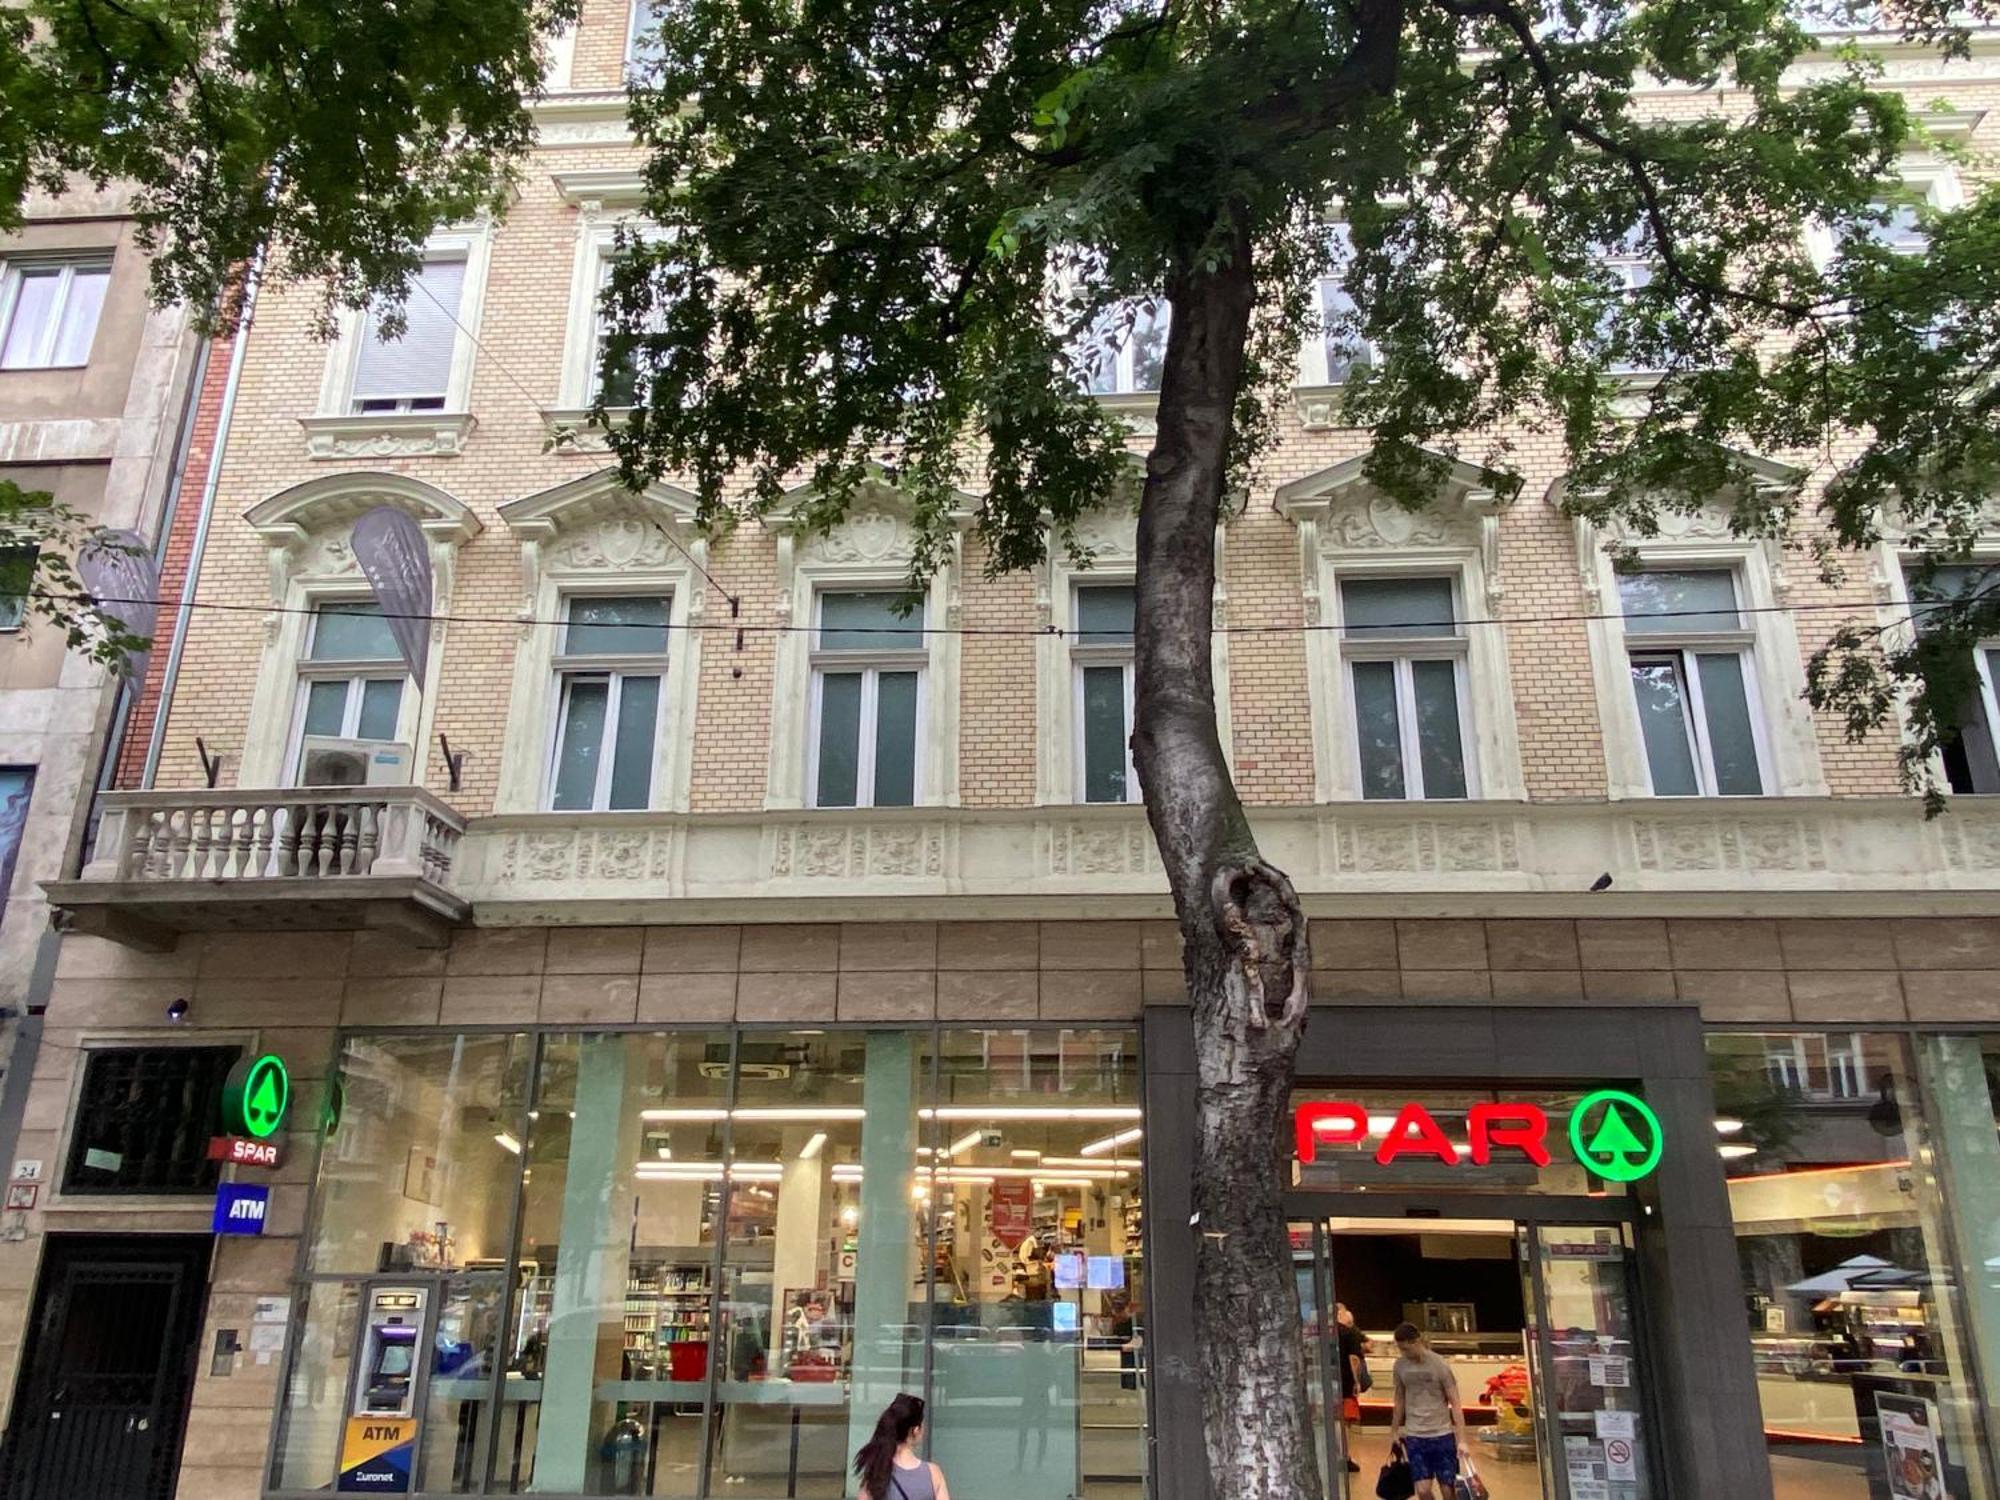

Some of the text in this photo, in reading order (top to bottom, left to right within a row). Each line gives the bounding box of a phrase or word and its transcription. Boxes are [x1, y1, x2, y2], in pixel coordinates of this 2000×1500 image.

[1295, 1102, 1550, 1165] PAR
[233, 1140, 277, 1163] SPAR
[19, 1166, 36, 1178] 24
[228, 1199, 265, 1219] ATM
[362, 1426, 400, 1441] ATM
[355, 1471, 394, 1482] Euronet
